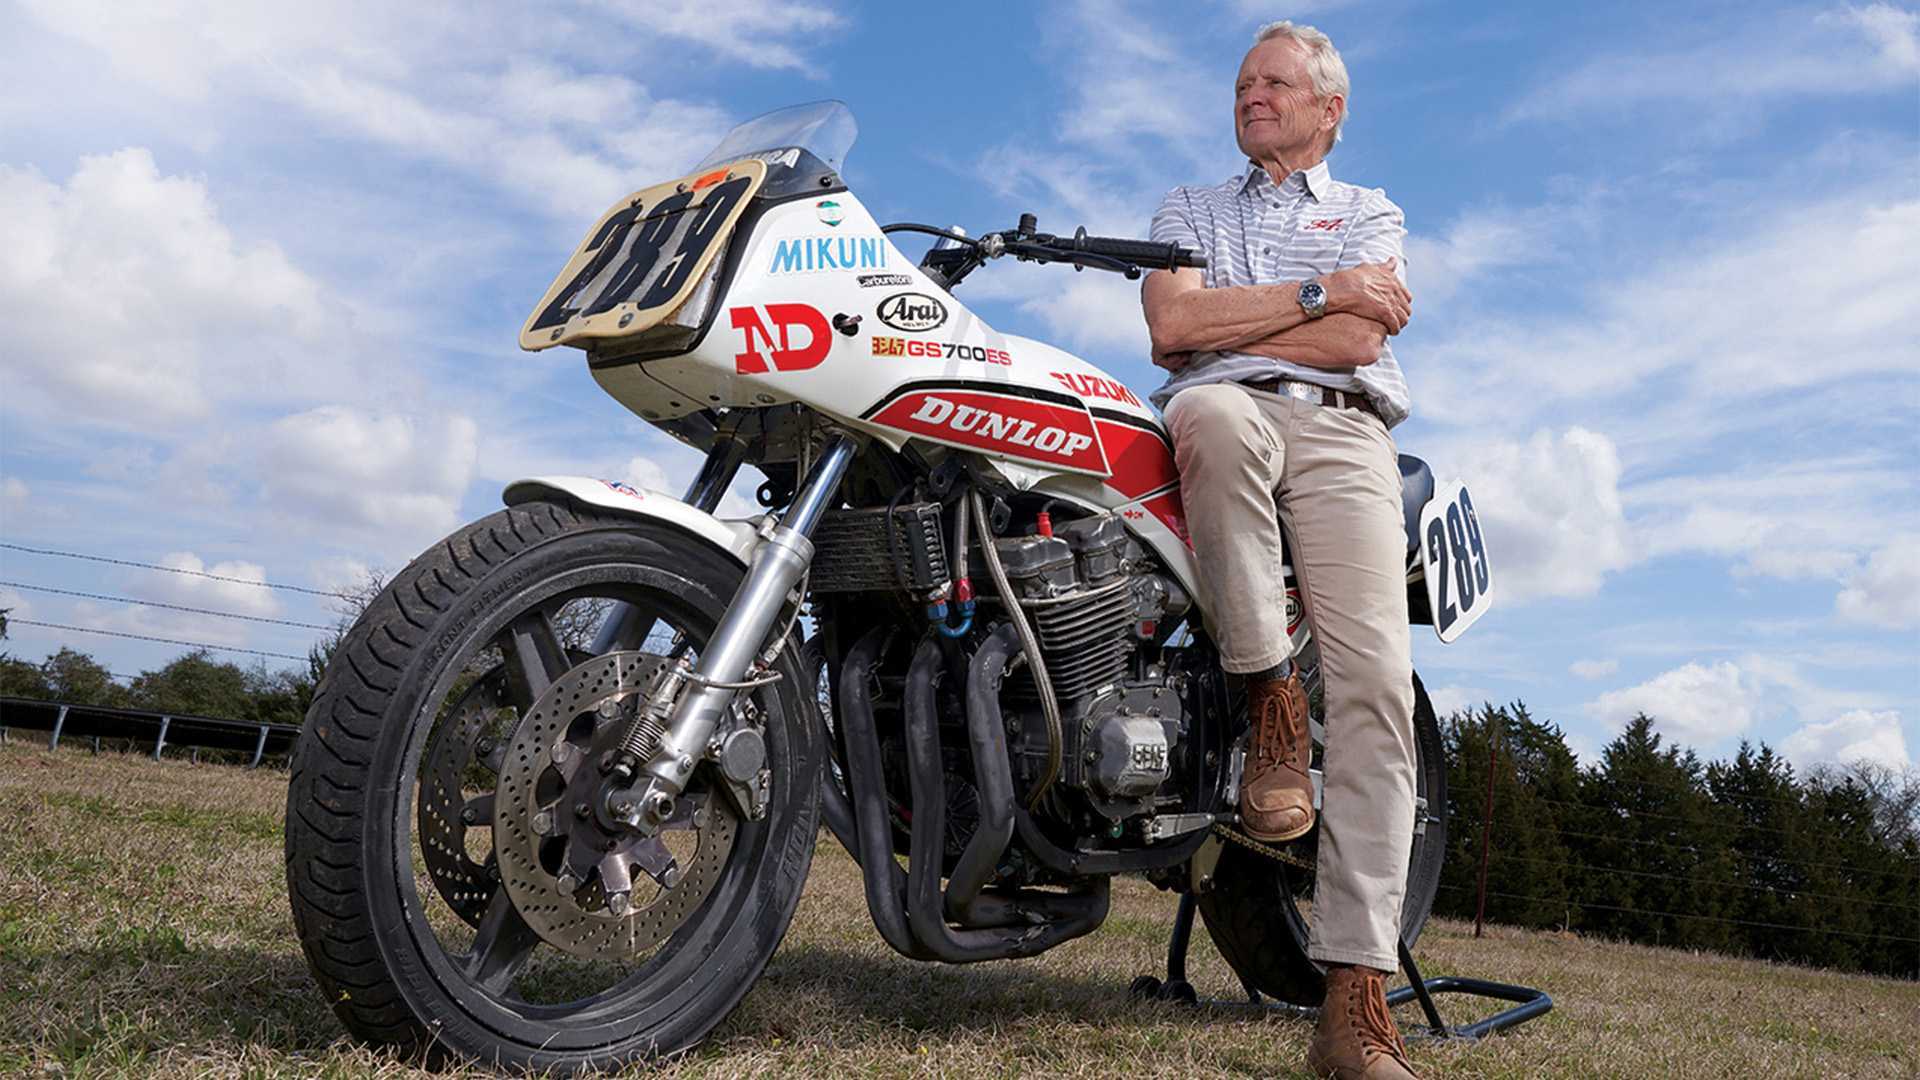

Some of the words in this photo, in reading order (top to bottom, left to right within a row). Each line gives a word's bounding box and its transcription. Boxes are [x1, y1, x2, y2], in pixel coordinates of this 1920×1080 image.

[529, 176, 752, 332] 289
[769, 237, 886, 273] MIKUNI
[729, 303, 833, 375] ND
[884, 297, 940, 321] Arai
[907, 339, 1013, 366] GS700ES
[910, 395, 1093, 457] DUNLOP
[1427, 486, 1489, 635] 289
